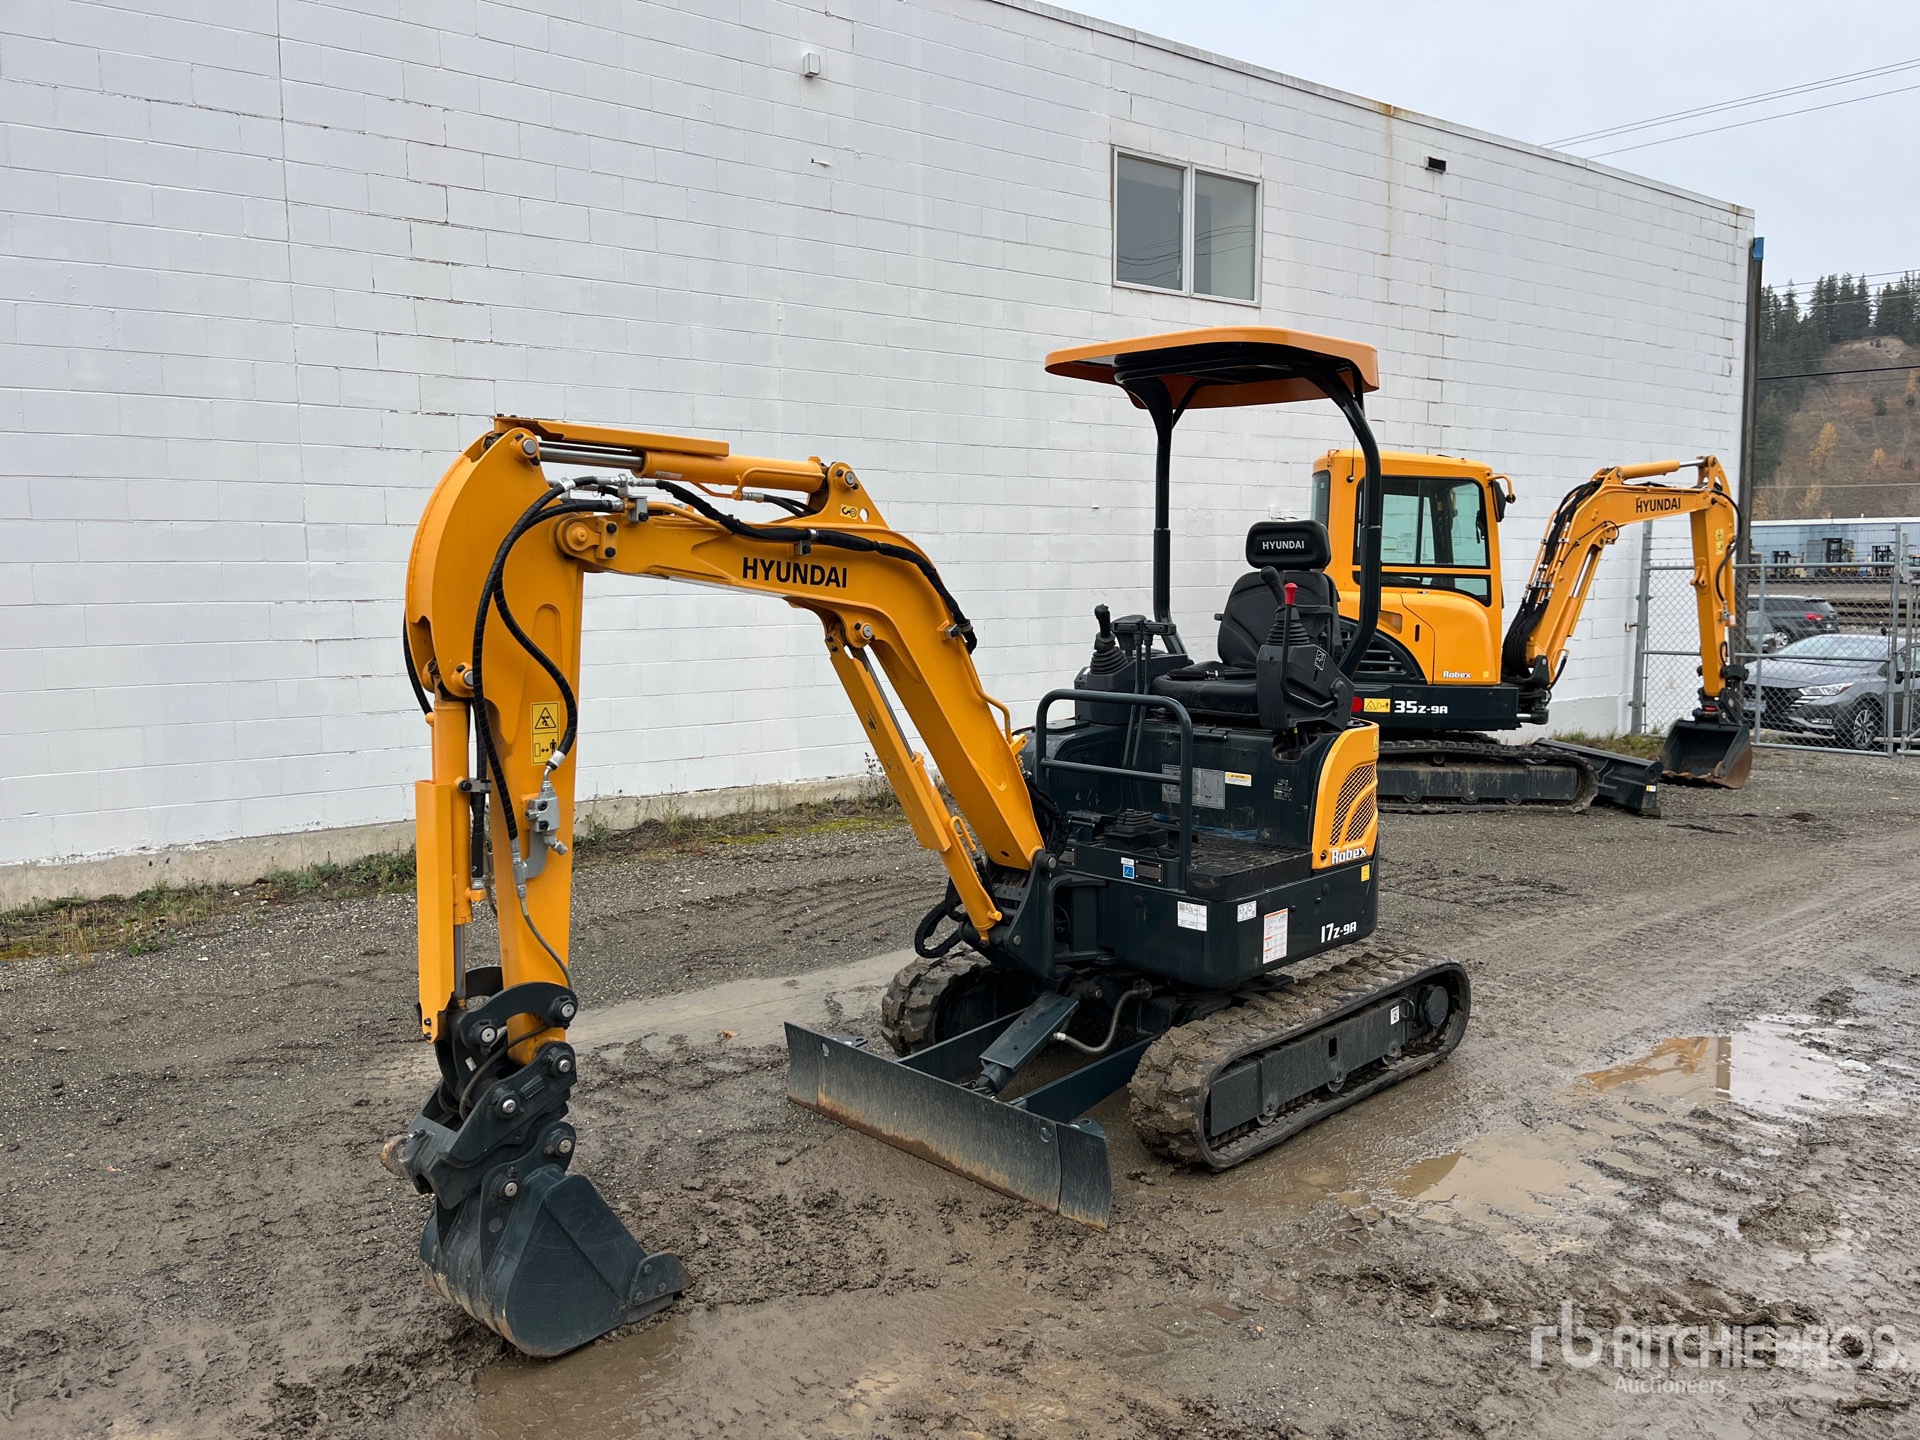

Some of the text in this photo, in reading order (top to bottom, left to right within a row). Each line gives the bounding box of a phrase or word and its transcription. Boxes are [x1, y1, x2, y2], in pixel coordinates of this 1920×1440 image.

[1635, 498, 1681, 513] HYUNDAI
[1262, 540, 1305, 550] HYUNDAI
[742, 556, 848, 588] HYUNDAI
[1443, 670, 1472, 679] Robex
[1331, 845, 1368, 865] Robex
